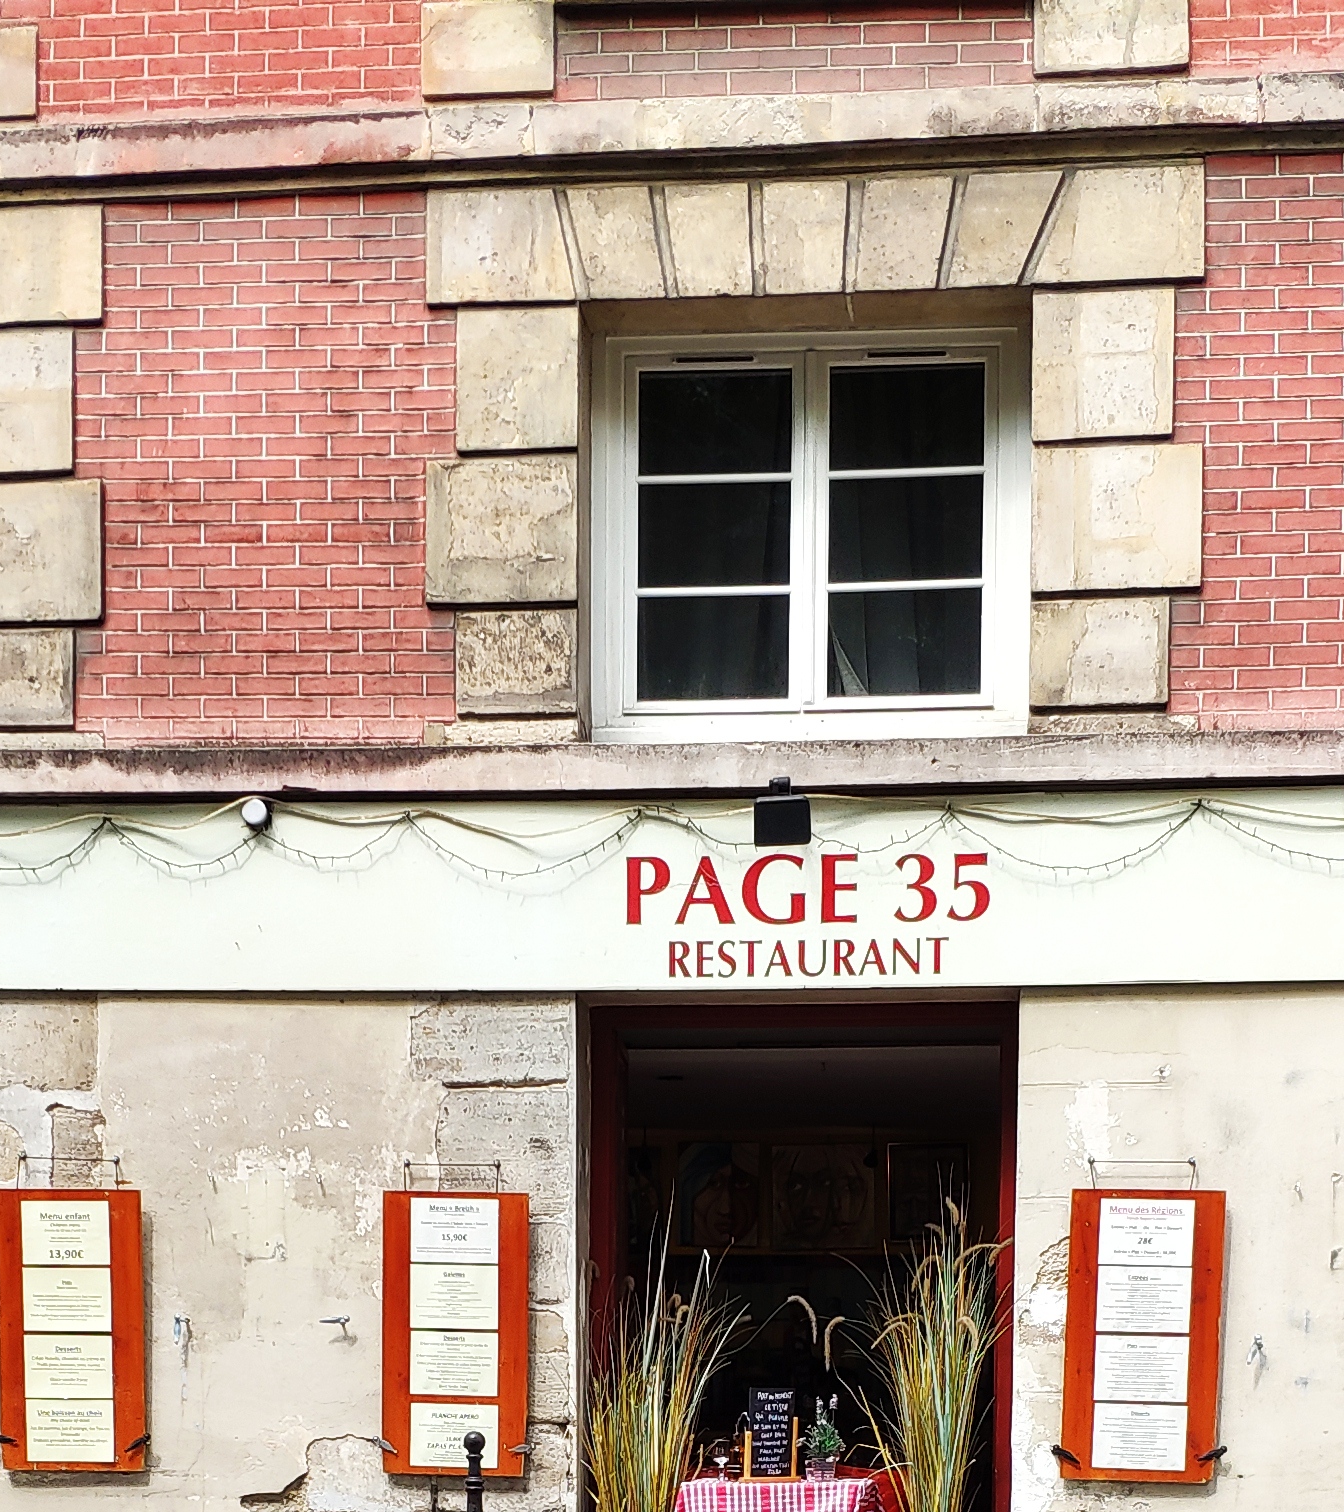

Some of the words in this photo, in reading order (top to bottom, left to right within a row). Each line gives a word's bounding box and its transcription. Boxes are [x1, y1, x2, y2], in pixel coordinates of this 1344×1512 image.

[625, 853, 859, 925] PAGE
[893, 852, 991, 923] 35
[668, 936, 950, 978] RESTAURANT
[1109, 1205, 1133, 1214] Menu
[1134, 1205, 1150, 1214] des
[39, 1212, 63, 1221] Menu
[64, 1212, 90, 1221] enfant
[441, 1233, 468, 1243] 15,90€
[49, 1249, 85, 1261] 13,90€
